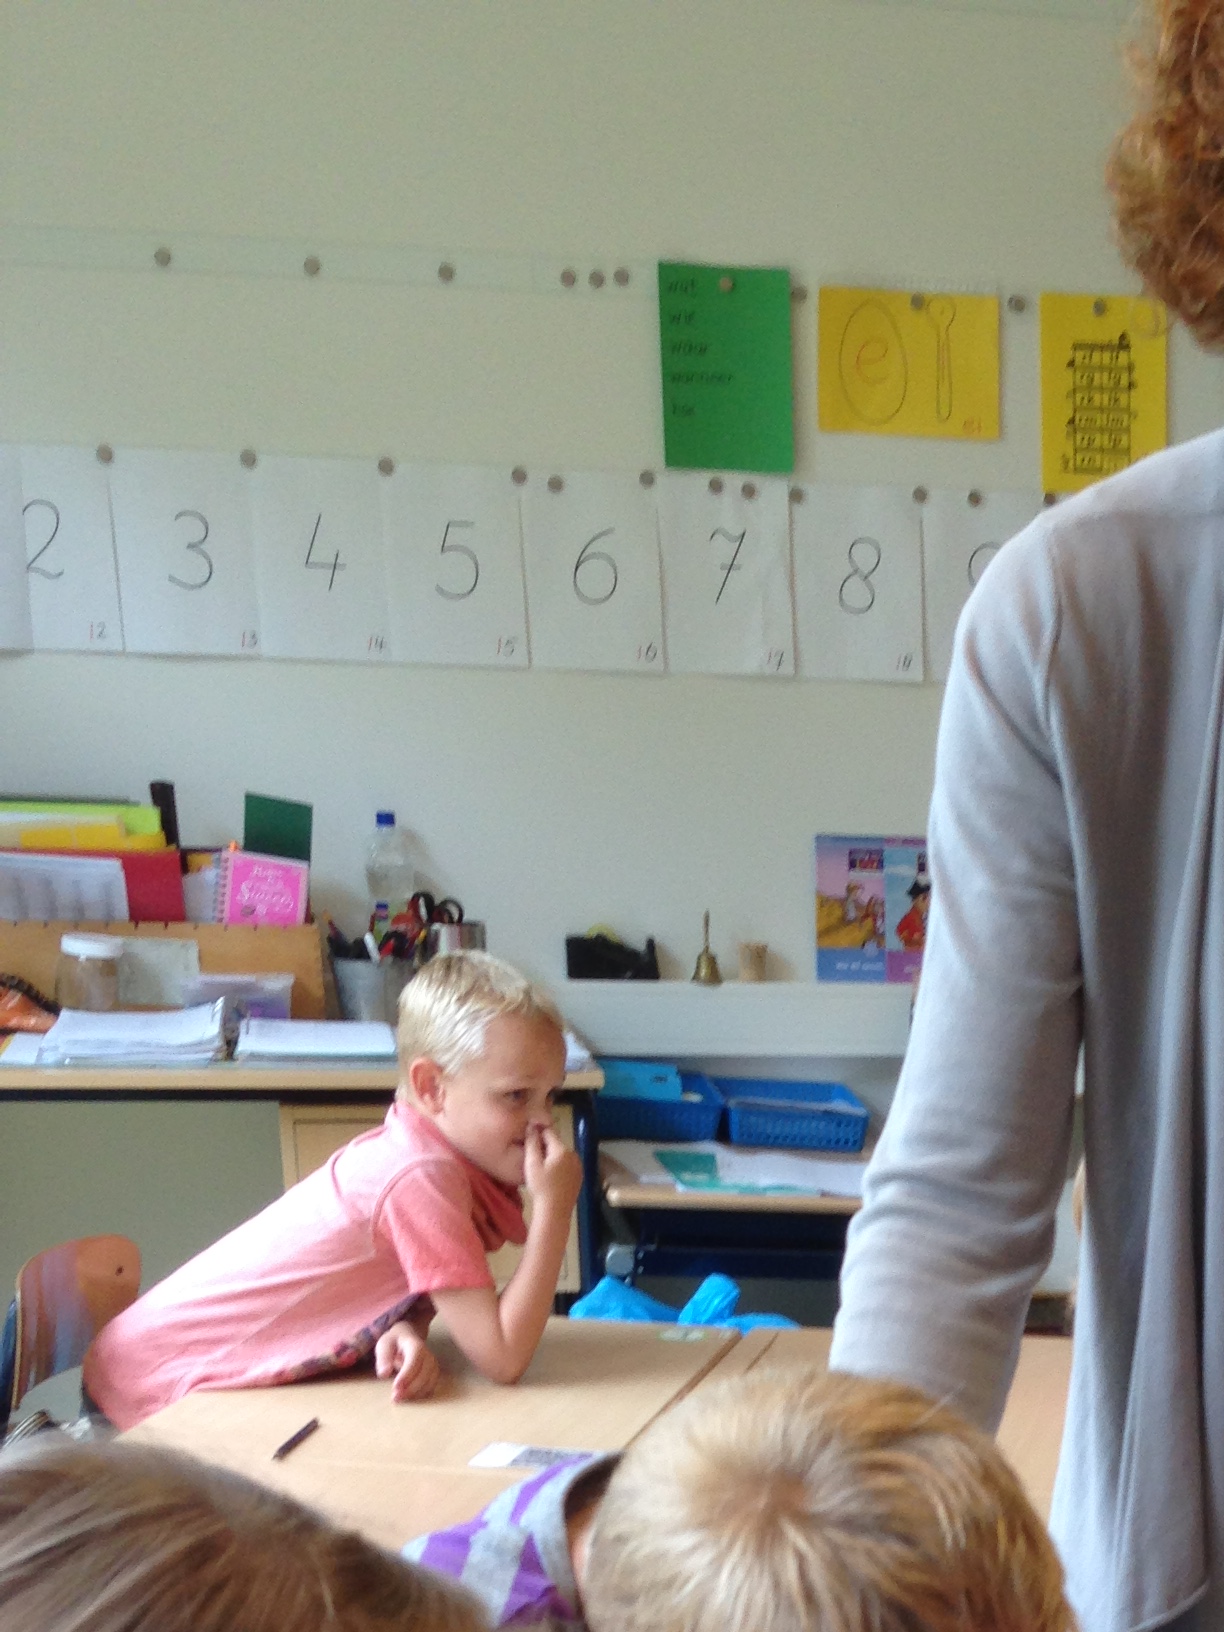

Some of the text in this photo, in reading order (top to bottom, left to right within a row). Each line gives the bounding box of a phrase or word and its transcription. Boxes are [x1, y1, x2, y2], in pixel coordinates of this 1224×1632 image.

[21, 498, 65, 580] 2
[167, 509, 214, 591] 3
[304, 512, 348, 592] 4
[434, 519, 481, 600] 5
[572, 526, 619, 606] 6
[709, 526, 748, 606] 7
[837, 536, 882, 616] 8
[89, 621, 107, 641] 12
[240, 629, 259, 650] 13
[367, 635, 386, 653] 14
[496, 636, 517, 658] 15
[637, 641, 658, 662] 16
